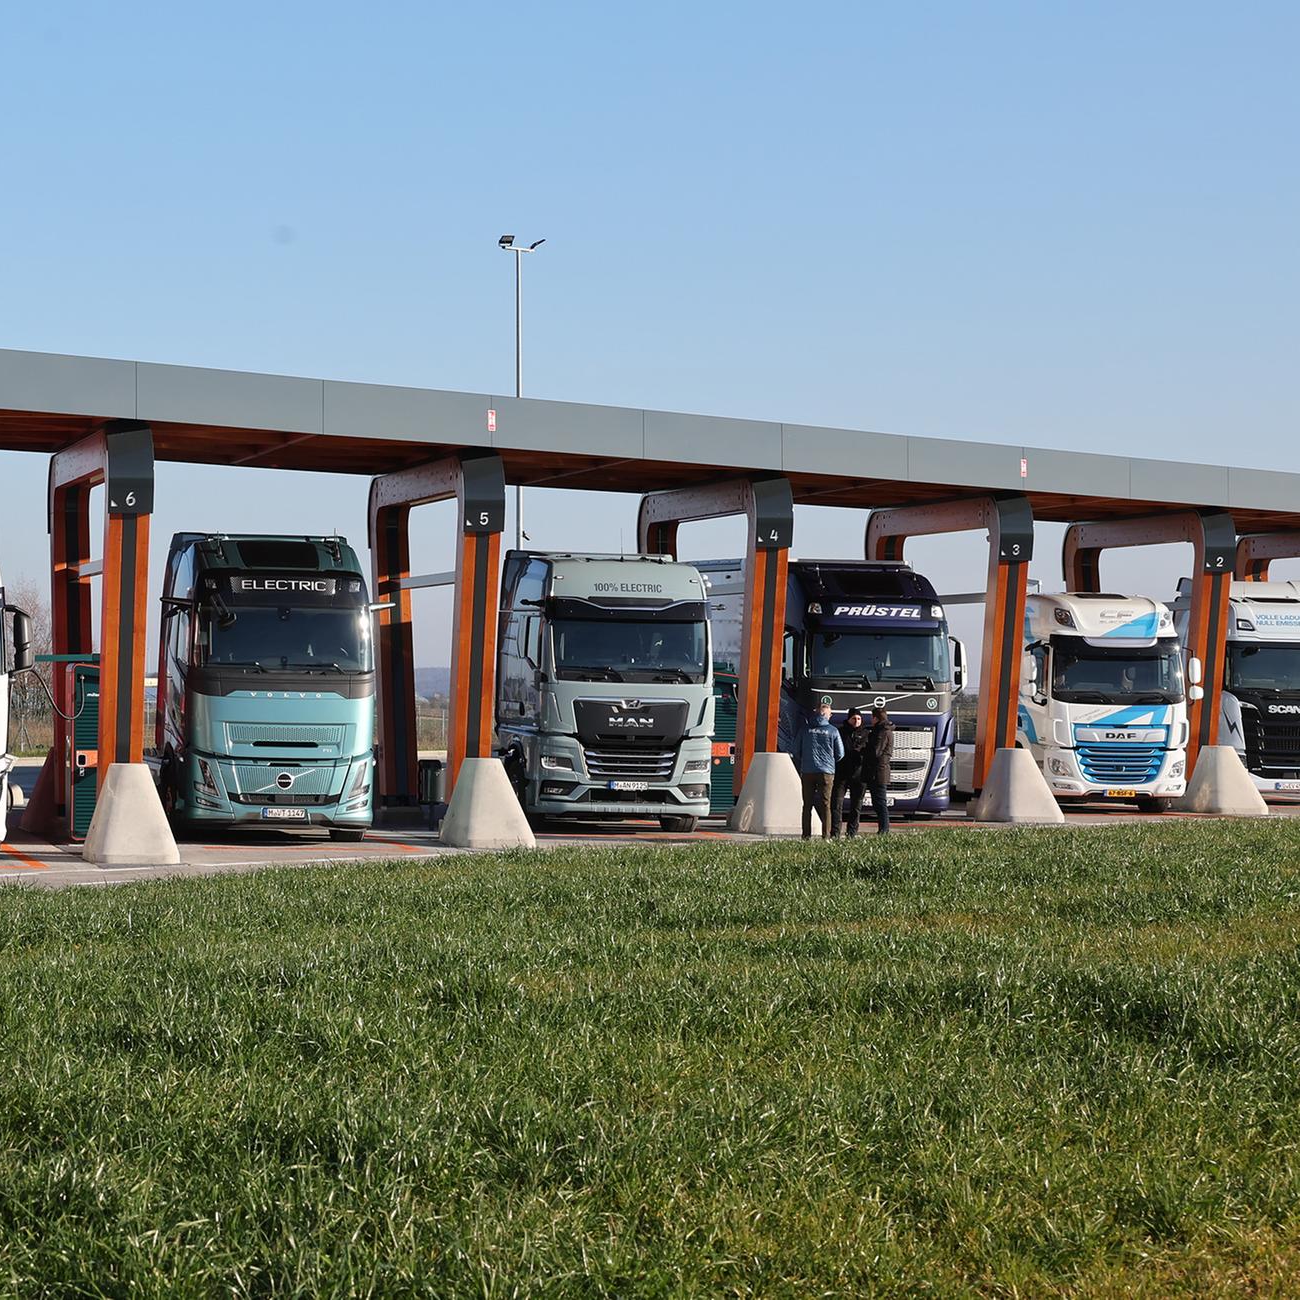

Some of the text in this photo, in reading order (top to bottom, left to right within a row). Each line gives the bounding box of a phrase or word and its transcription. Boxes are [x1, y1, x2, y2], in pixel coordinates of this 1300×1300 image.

[126, 491, 136, 506] 6
[479, 512, 489, 526] 5
[770, 529, 779, 541] 4
[1012, 544, 1020, 556] 3
[1216, 556, 1224, 567] 2
[241, 580, 327, 592] ELECTRIC
[593, 582, 662, 593] 100% ELECTRIC
[833, 605, 921, 618] PRÜSTEL
[608, 717, 654, 728] MAN
